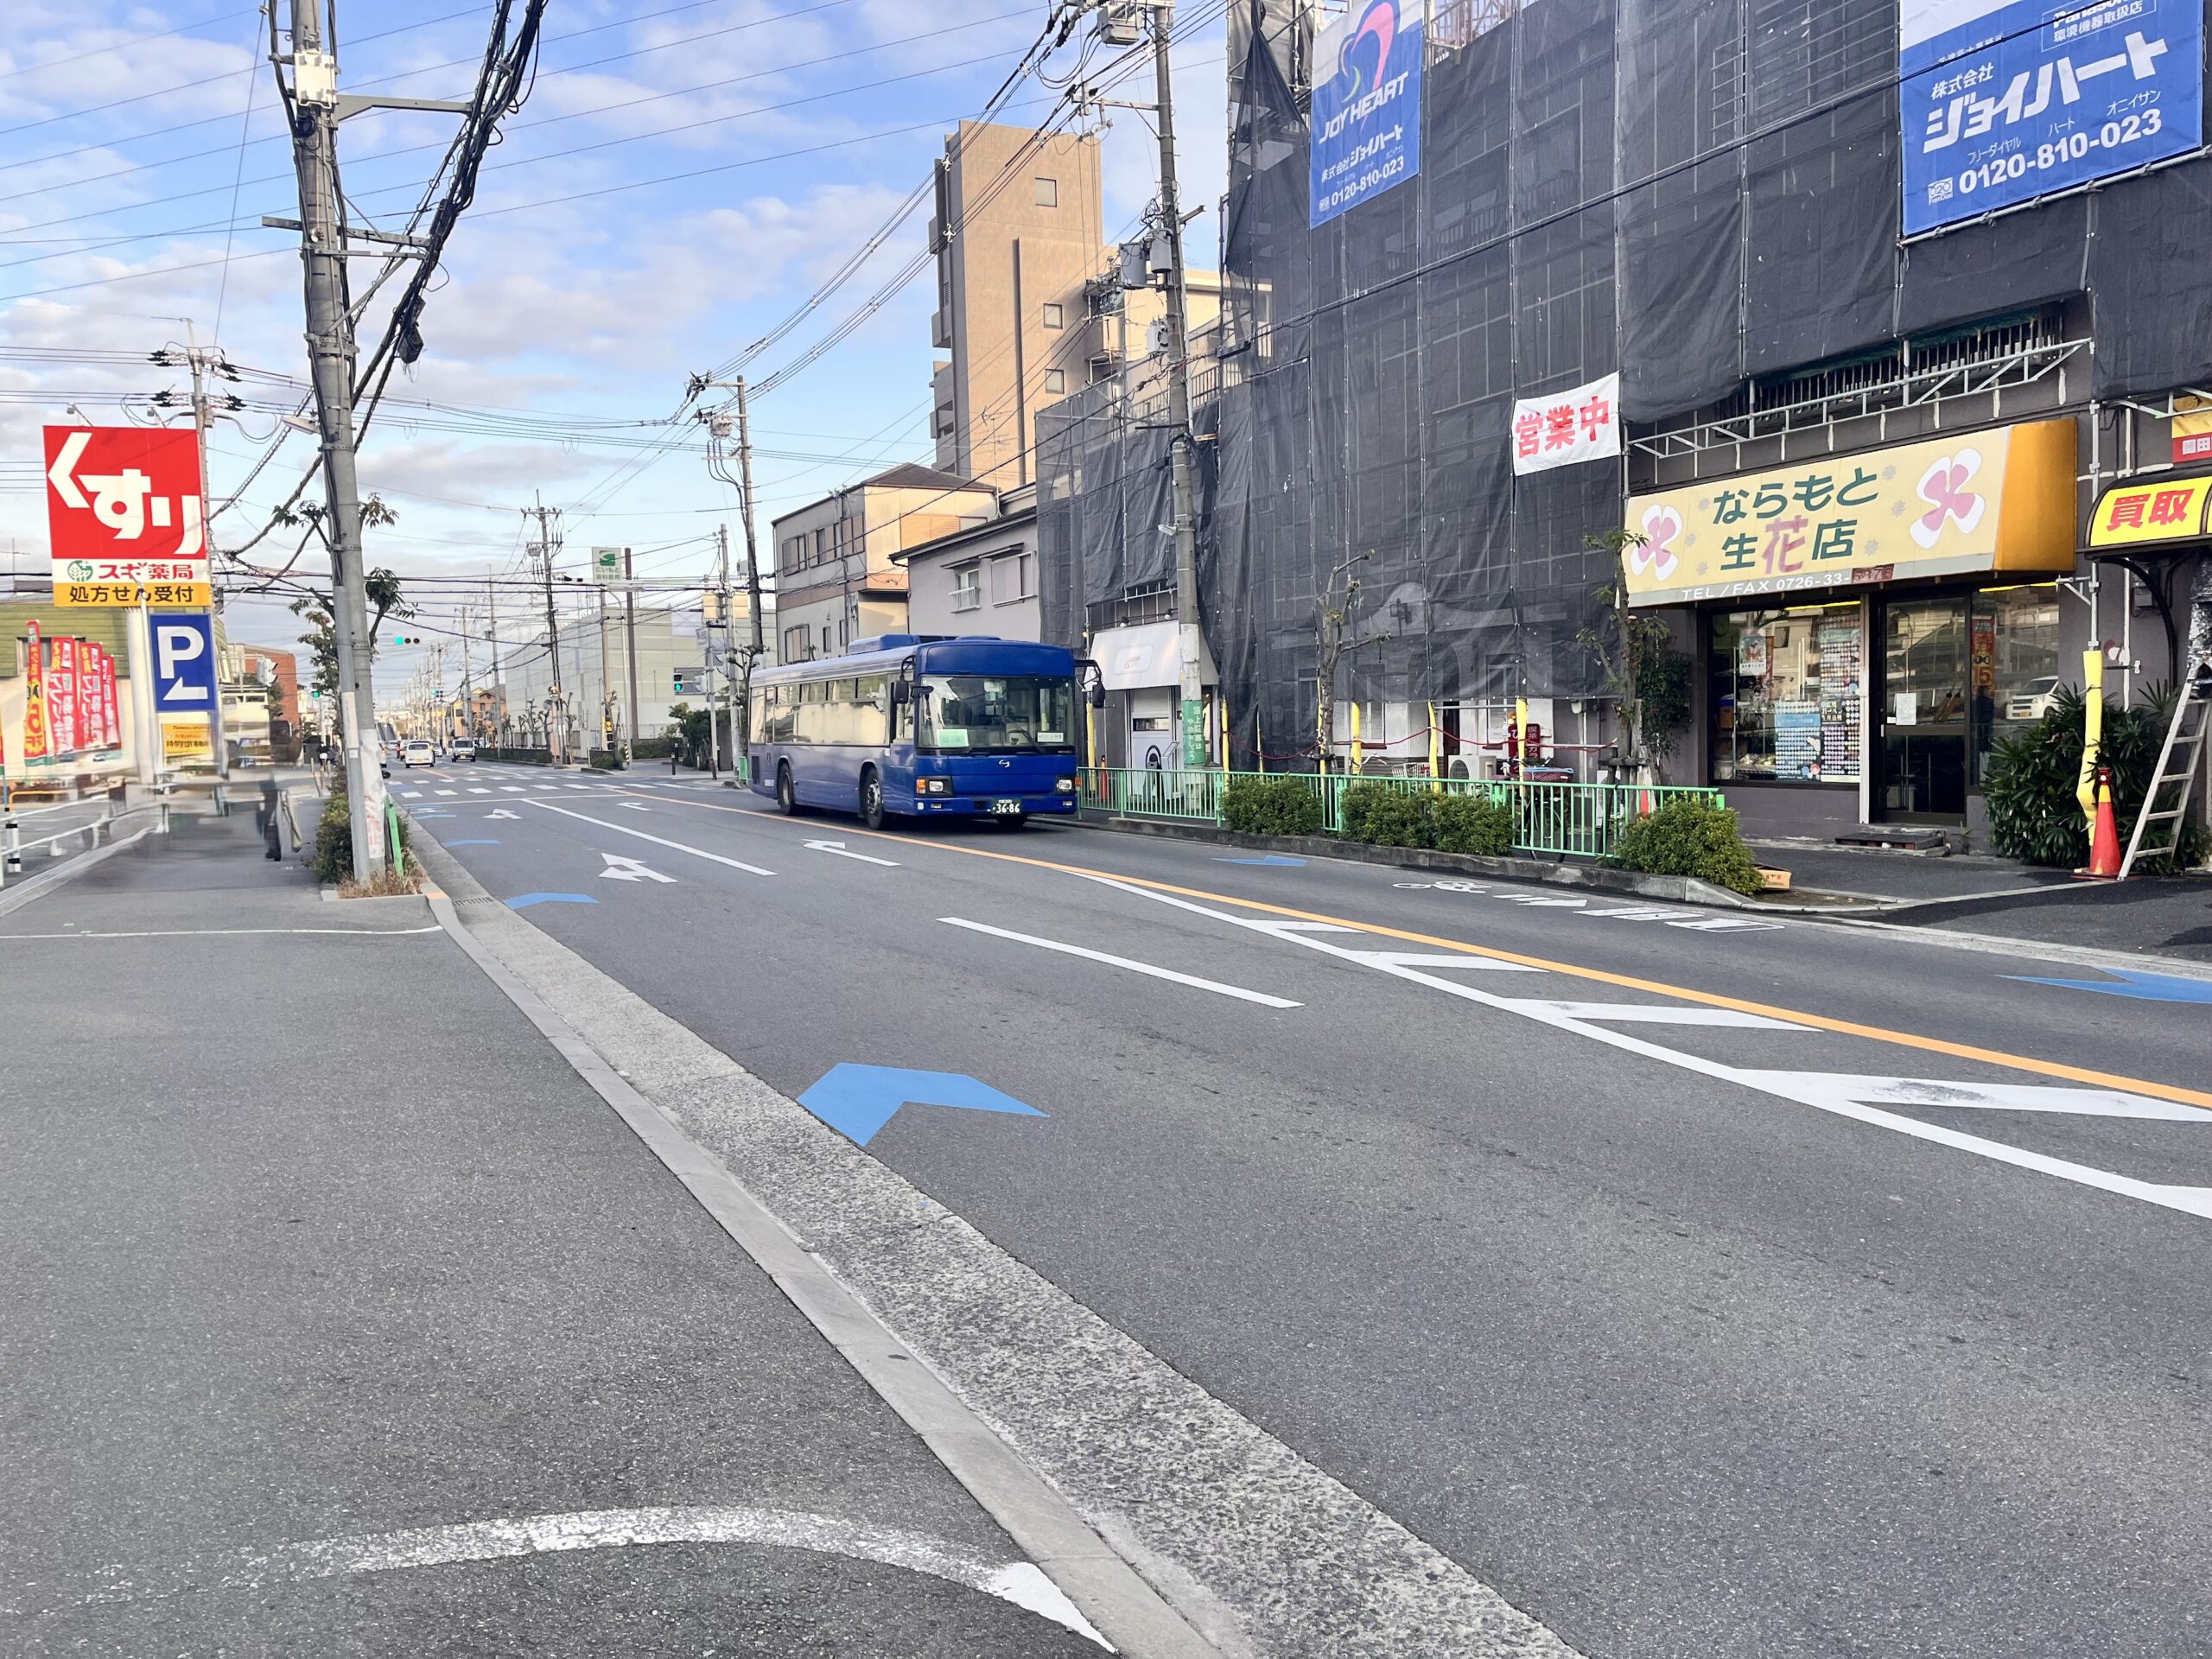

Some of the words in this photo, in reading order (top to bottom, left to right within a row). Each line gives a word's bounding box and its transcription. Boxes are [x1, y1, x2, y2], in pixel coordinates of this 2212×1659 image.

[2054, 2, 2143, 42] 環境機器取扱店
[1923, 31, 2169, 154] ジョイハート
[1931, 62, 1994, 100] 株式会社
[2106, 90, 2162, 118] オニイサン
[1319, 107, 1350, 144] JOY
[1350, 71, 1409, 124] HEART
[2048, 117, 2076, 137] ハート
[1959, 108, 2163, 194] 0120-810-023
[1967, 136, 2023, 165] フリーダイヤル
[1331, 156, 1404, 207] 0120-810-023
[1515, 395, 1609, 459] 営業中
[48, 431, 204, 556] くすり
[1713, 467, 1879, 524] ならもと
[2106, 488, 2196, 532] 買取
[1720, 514, 1858, 575] 生花店
[69, 585, 194, 603] 処方せん受付
[98, 562, 194, 580] スギ薬局
[156, 626, 205, 679] P
